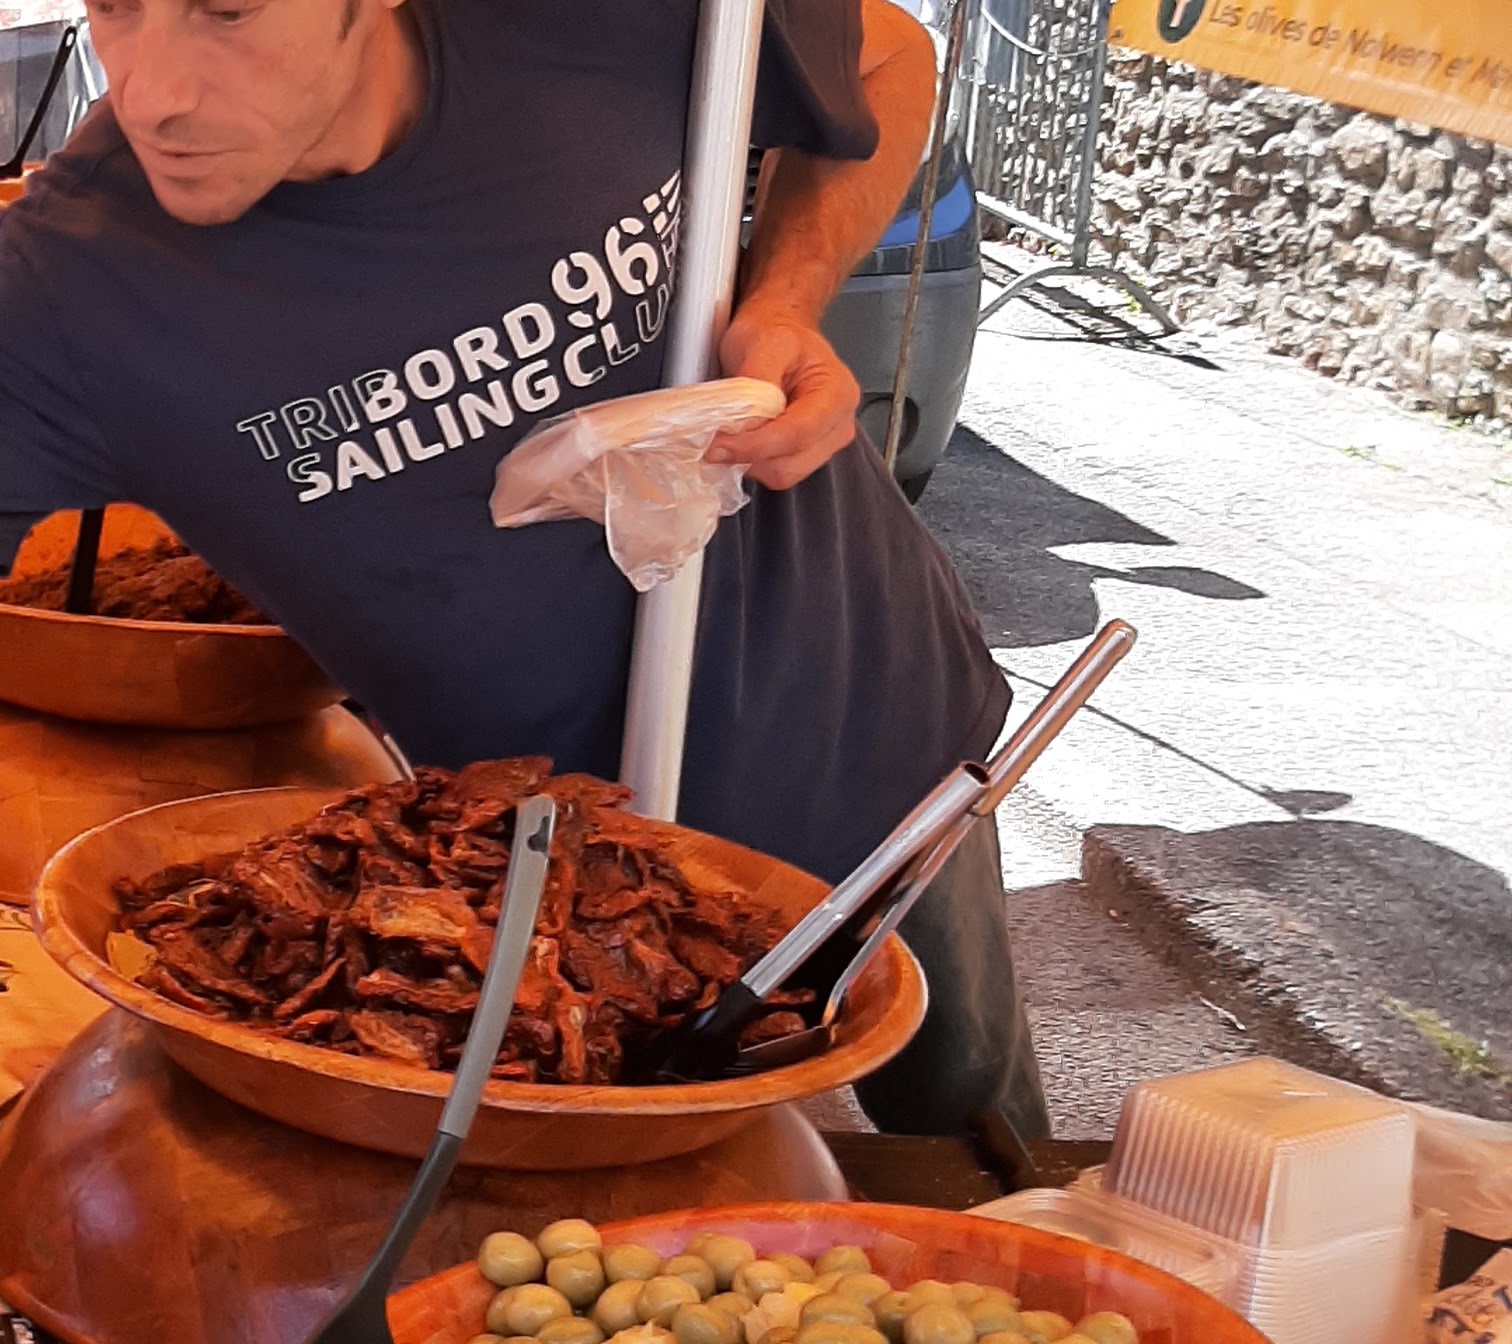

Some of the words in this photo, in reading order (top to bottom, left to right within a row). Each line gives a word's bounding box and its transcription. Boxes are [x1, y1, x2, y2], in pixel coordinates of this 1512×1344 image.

[1246, 4, 1306, 42] olives
[1308, 20, 1340, 49] de
[551, 217, 660, 328] 96
[237, 301, 556, 460] TRIBORD
[562, 283, 670, 387] CLU
